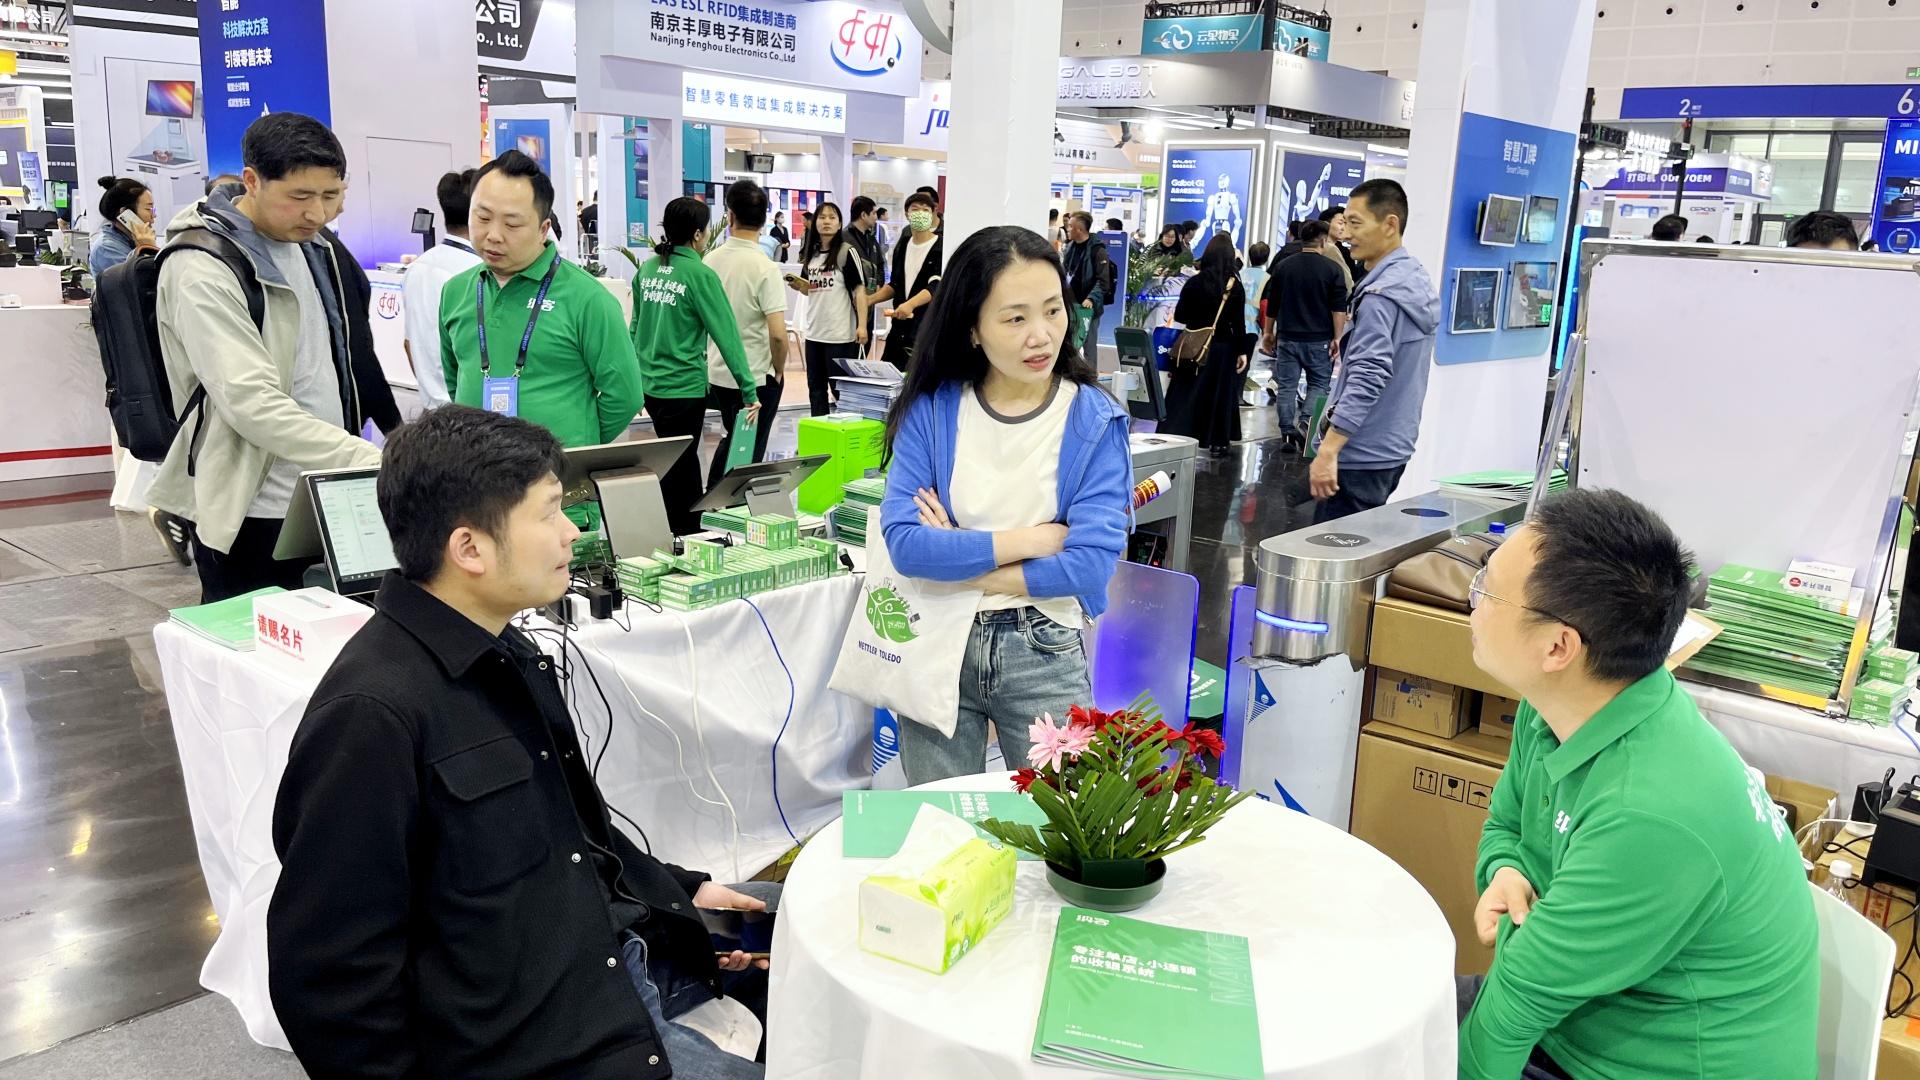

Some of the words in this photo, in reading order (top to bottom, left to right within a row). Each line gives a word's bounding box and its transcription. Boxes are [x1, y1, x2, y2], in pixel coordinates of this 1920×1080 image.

[223, 17, 269, 38] 科技解决方案
[650, 11, 796, 52] 南京丰厚电子有限公司
[497, 33, 523, 48] Ltd.
[650, 32, 685, 48] Nanjing
[687, 38, 723, 52] Fenghou
[725, 44, 767, 59] Electronics
[224, 47, 272, 68] 引领零售未来
[1060, 65, 1159, 79] GALBOT
[685, 86, 844, 120] 智慧零售领域集成解决方案
[1679, 98, 1691, 116] 2
[1897, 88, 1914, 115] 6
[1894, 139, 1920, 155] MI
[257, 613, 304, 652] 请赐名片
[879, 649, 902, 664] TOLEDO
